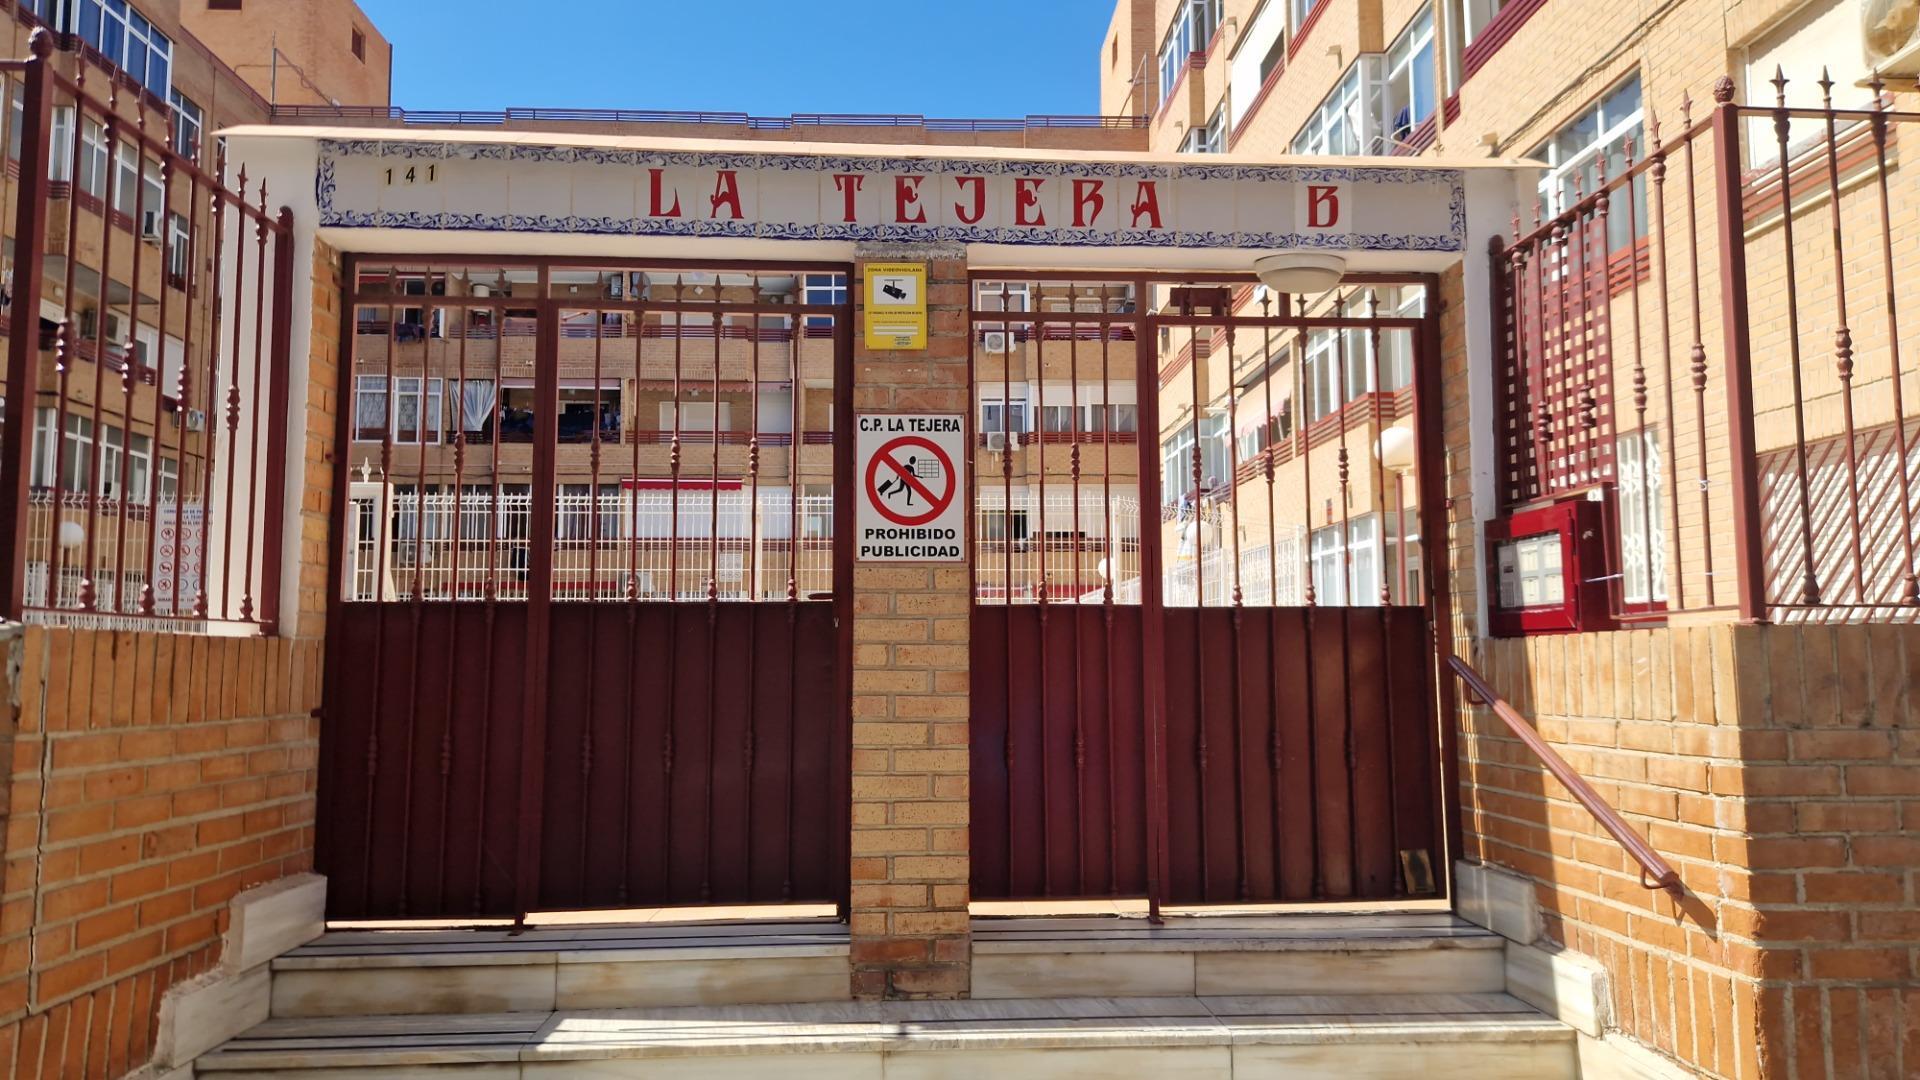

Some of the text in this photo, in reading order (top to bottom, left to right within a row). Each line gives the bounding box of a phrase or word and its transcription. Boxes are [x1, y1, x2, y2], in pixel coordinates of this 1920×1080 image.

[386, 164, 435, 185] 141
[648, 168, 1163, 229] LA TEJERA
[1307, 185, 1339, 228] B
[860, 418, 961, 433] C.P. LA TEJERA
[865, 528, 956, 540] PROHIBIDO
[861, 545, 960, 557] PUBLICIDAD
